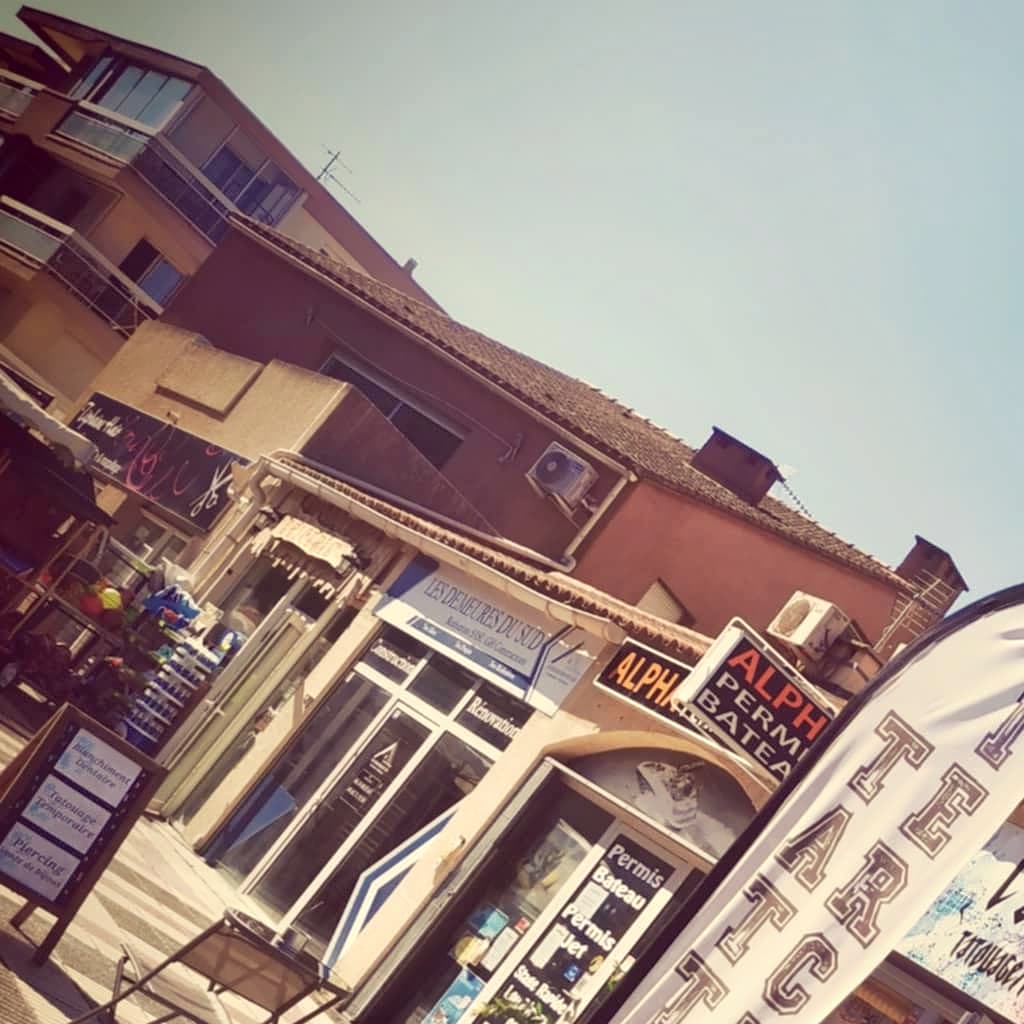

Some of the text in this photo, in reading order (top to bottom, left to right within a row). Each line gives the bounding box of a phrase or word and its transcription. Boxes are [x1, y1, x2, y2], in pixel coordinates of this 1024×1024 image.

[424, 577, 448, 602] LES
[442, 585, 503, 630] DEMEURES
[497, 612, 524, 641] DU
[515, 622, 546, 653] SUD
[728, 648, 829, 741] ALPH
[696, 688, 793, 783] BATEA
[35, 797, 96, 839] Temporaire
[49, 790, 98, 825] Tatouage
[13, 837, 65, 876] Piercing
[607, 844, 665, 889] Permis
[592, 864, 647, 910] Bateau
[559, 932, 589, 959] Jet
[561, 903, 616, 951] Permis
